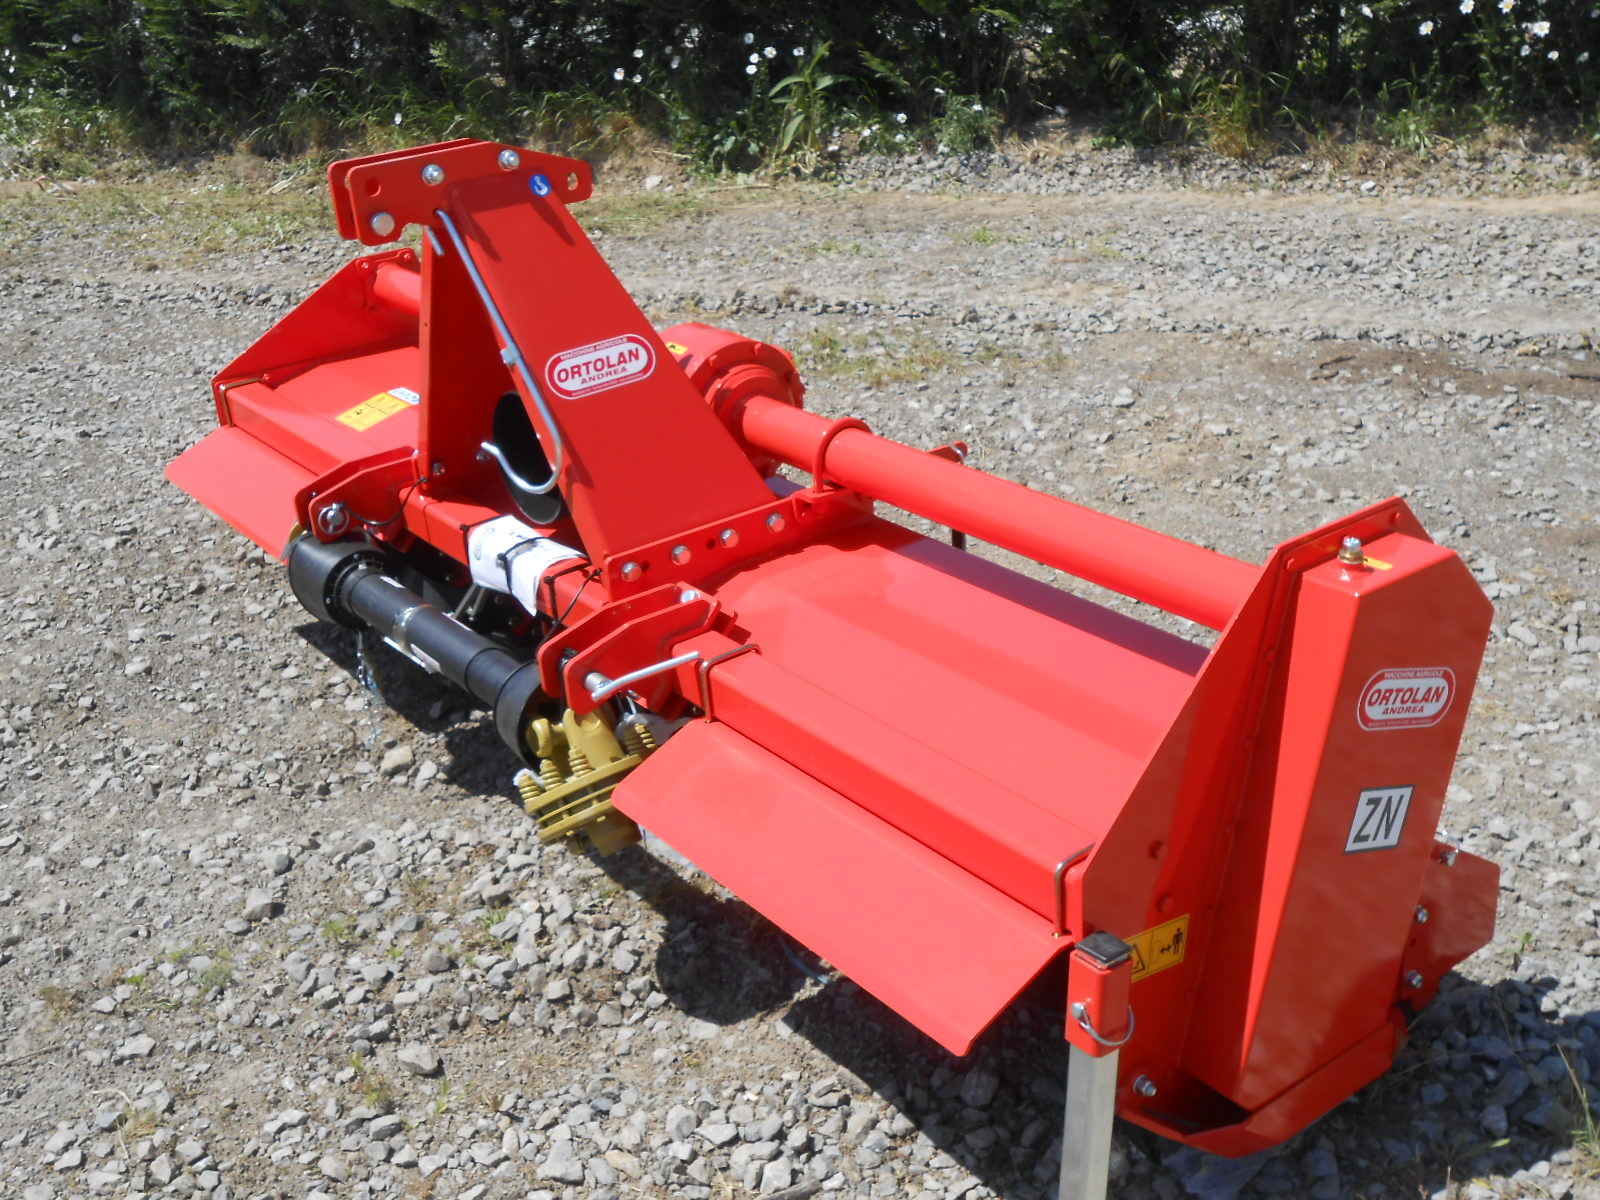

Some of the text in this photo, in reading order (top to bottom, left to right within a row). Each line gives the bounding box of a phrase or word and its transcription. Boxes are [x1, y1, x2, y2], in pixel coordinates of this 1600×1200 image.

[557, 347, 641, 383] ORTOLAN
[580, 366, 628, 385] ANDREA
[1367, 686, 1446, 707] ORTOLAN
[1381, 705, 1425, 715] ANDREA
[1352, 794, 1405, 844] ZN
